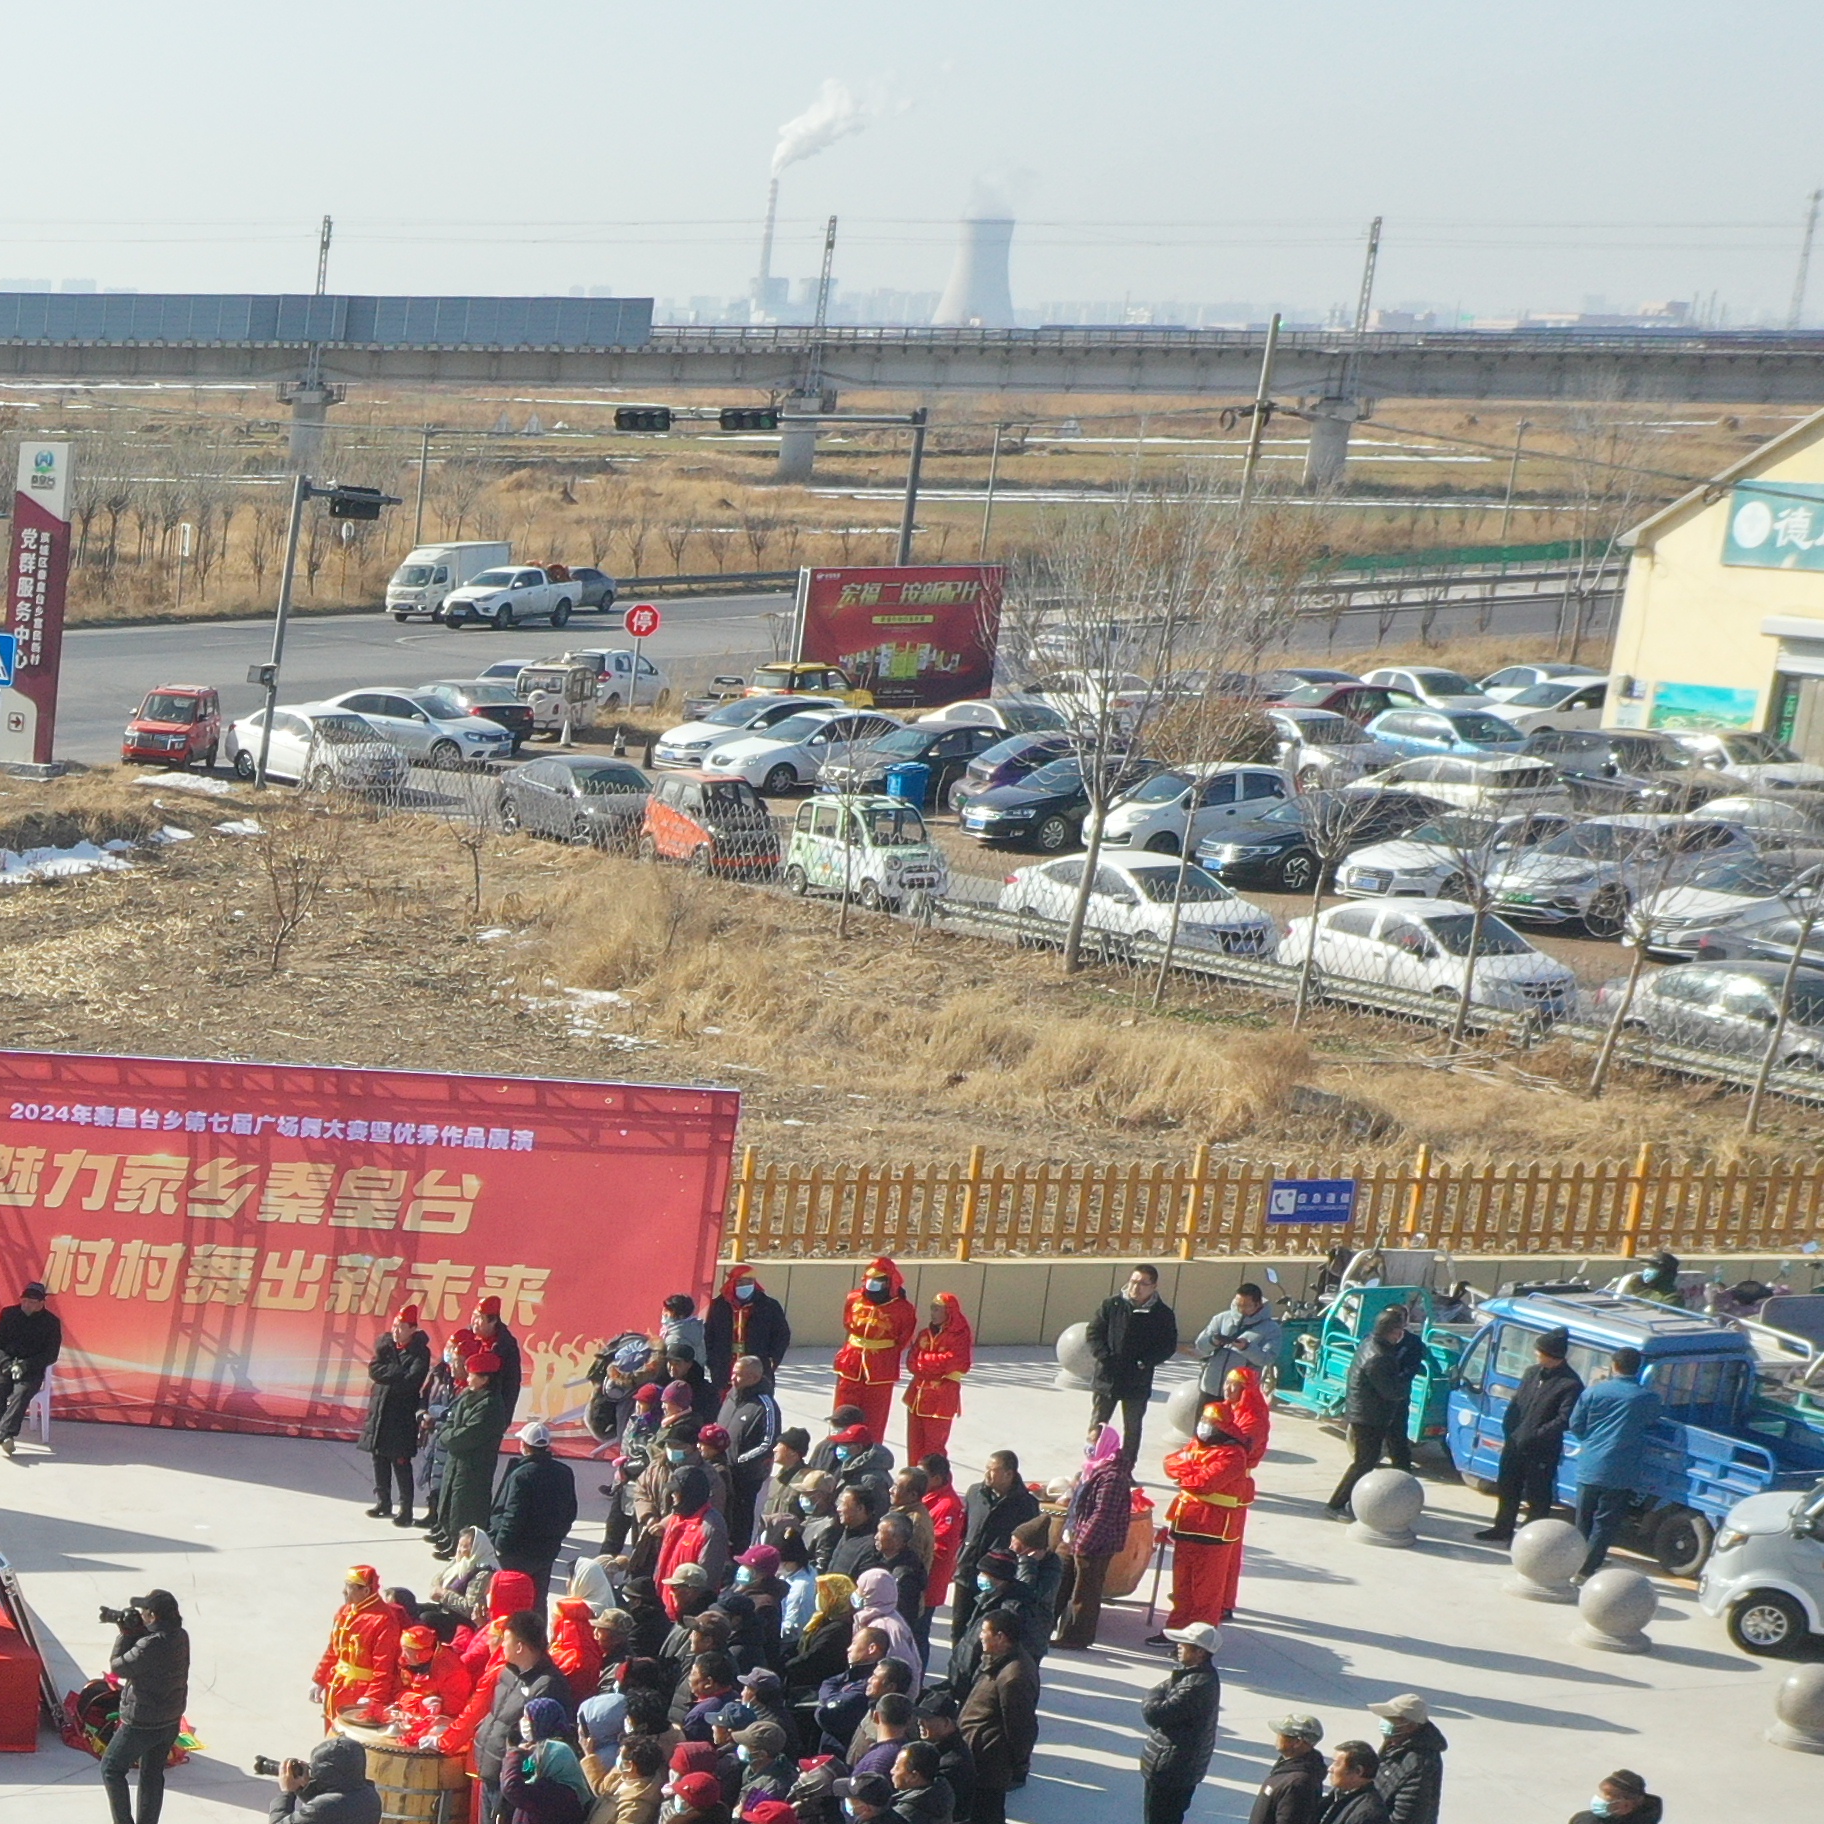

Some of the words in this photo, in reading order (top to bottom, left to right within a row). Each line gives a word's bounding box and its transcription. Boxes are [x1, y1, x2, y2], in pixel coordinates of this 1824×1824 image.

[14, 528, 39, 669] 党群服务中心
[632, 610, 653, 632] 停
[9, 1102, 535, 1153] 2024年秦皇台乡第七届广场舞大赛暨优秀作品展演
[42, 1235, 552, 1326] 村村舞出新未来
